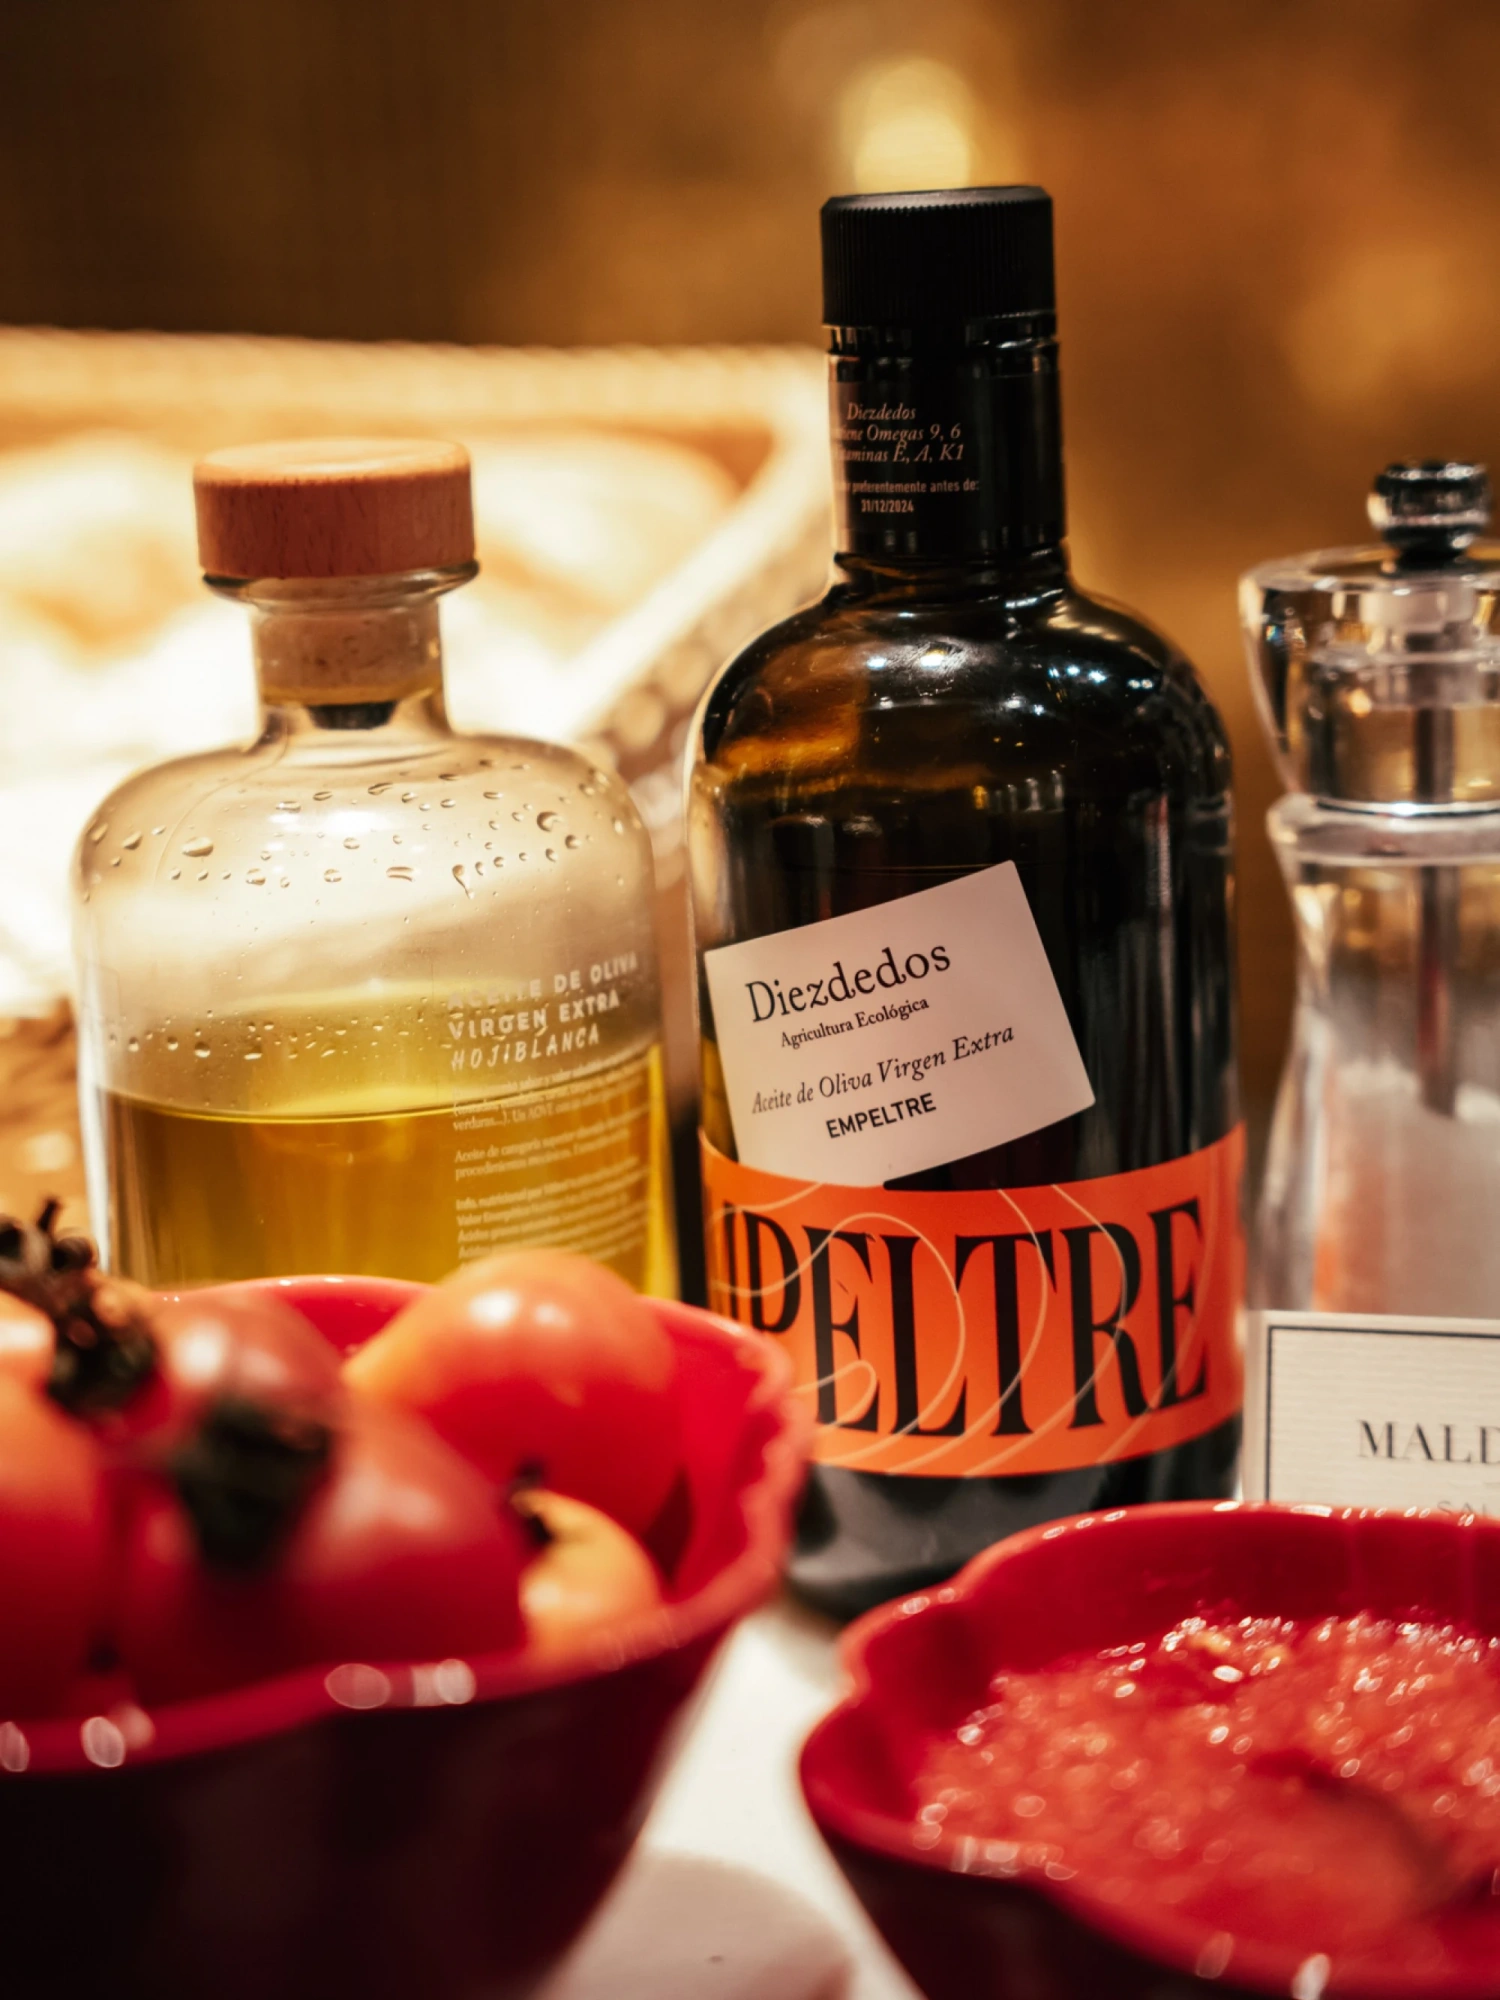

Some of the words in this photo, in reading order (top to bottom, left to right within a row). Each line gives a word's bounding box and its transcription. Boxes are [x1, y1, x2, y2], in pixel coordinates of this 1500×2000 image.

[847, 402, 916, 420] Diezdedos
[866, 424, 924, 446] Omegas
[930, 424, 944, 442] 9,
[950, 423, 962, 439] 6
[914, 445, 933, 464] A,
[939, 444, 965, 461] K1
[851, 480, 927, 495] preferentemente
[930, 480, 960, 493] antes
[861, 499, 914, 513] 31/12/2024
[554, 970, 582, 994] DE
[590, 951, 638, 985] OLIVA
[745, 944, 951, 1023] Diezdedos
[448, 1008, 547, 1040] VIRGEN
[558, 989, 621, 1023] EXTRA
[780, 1012, 854, 1050] Agricultura
[855, 998, 930, 1030] Ecológica
[451, 1022, 600, 1072] HOJIBLANCA
[751, 1089, 793, 1115] Aceite
[796, 1081, 814, 1105] de
[818, 1072, 873, 1098] Oliva
[876, 1049, 947, 1082] Virgen
[951, 1026, 1015, 1062] Extra
[825, 1092, 937, 1139] EMPELTRE
[454, 1149, 486, 1164] Aceite
[487, 1145, 500, 1159] de
